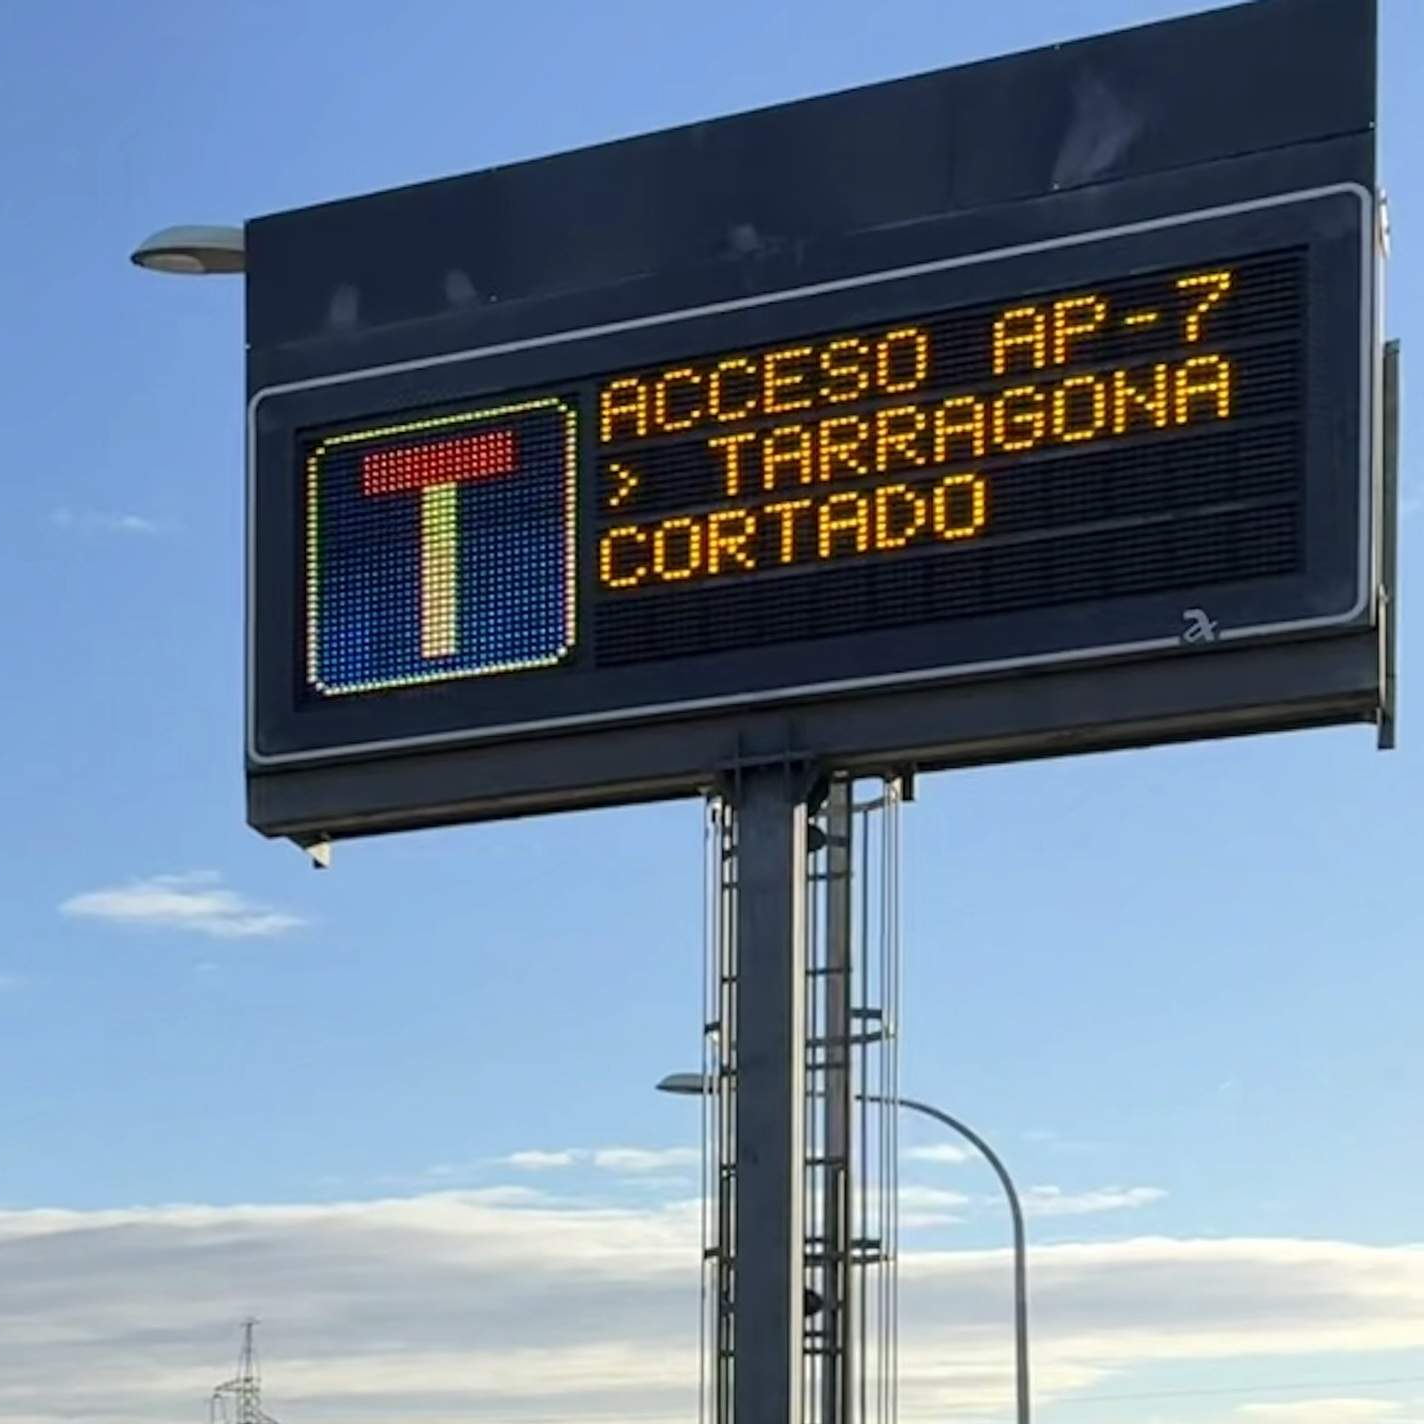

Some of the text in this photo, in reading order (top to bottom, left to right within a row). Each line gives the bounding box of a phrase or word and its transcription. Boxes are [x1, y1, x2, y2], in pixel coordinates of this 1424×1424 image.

[601, 272, 1231, 442] ACCESO AP-7
[709, 354, 1230, 496] TARRAGONA
[600, 473, 985, 587] CORTADO
